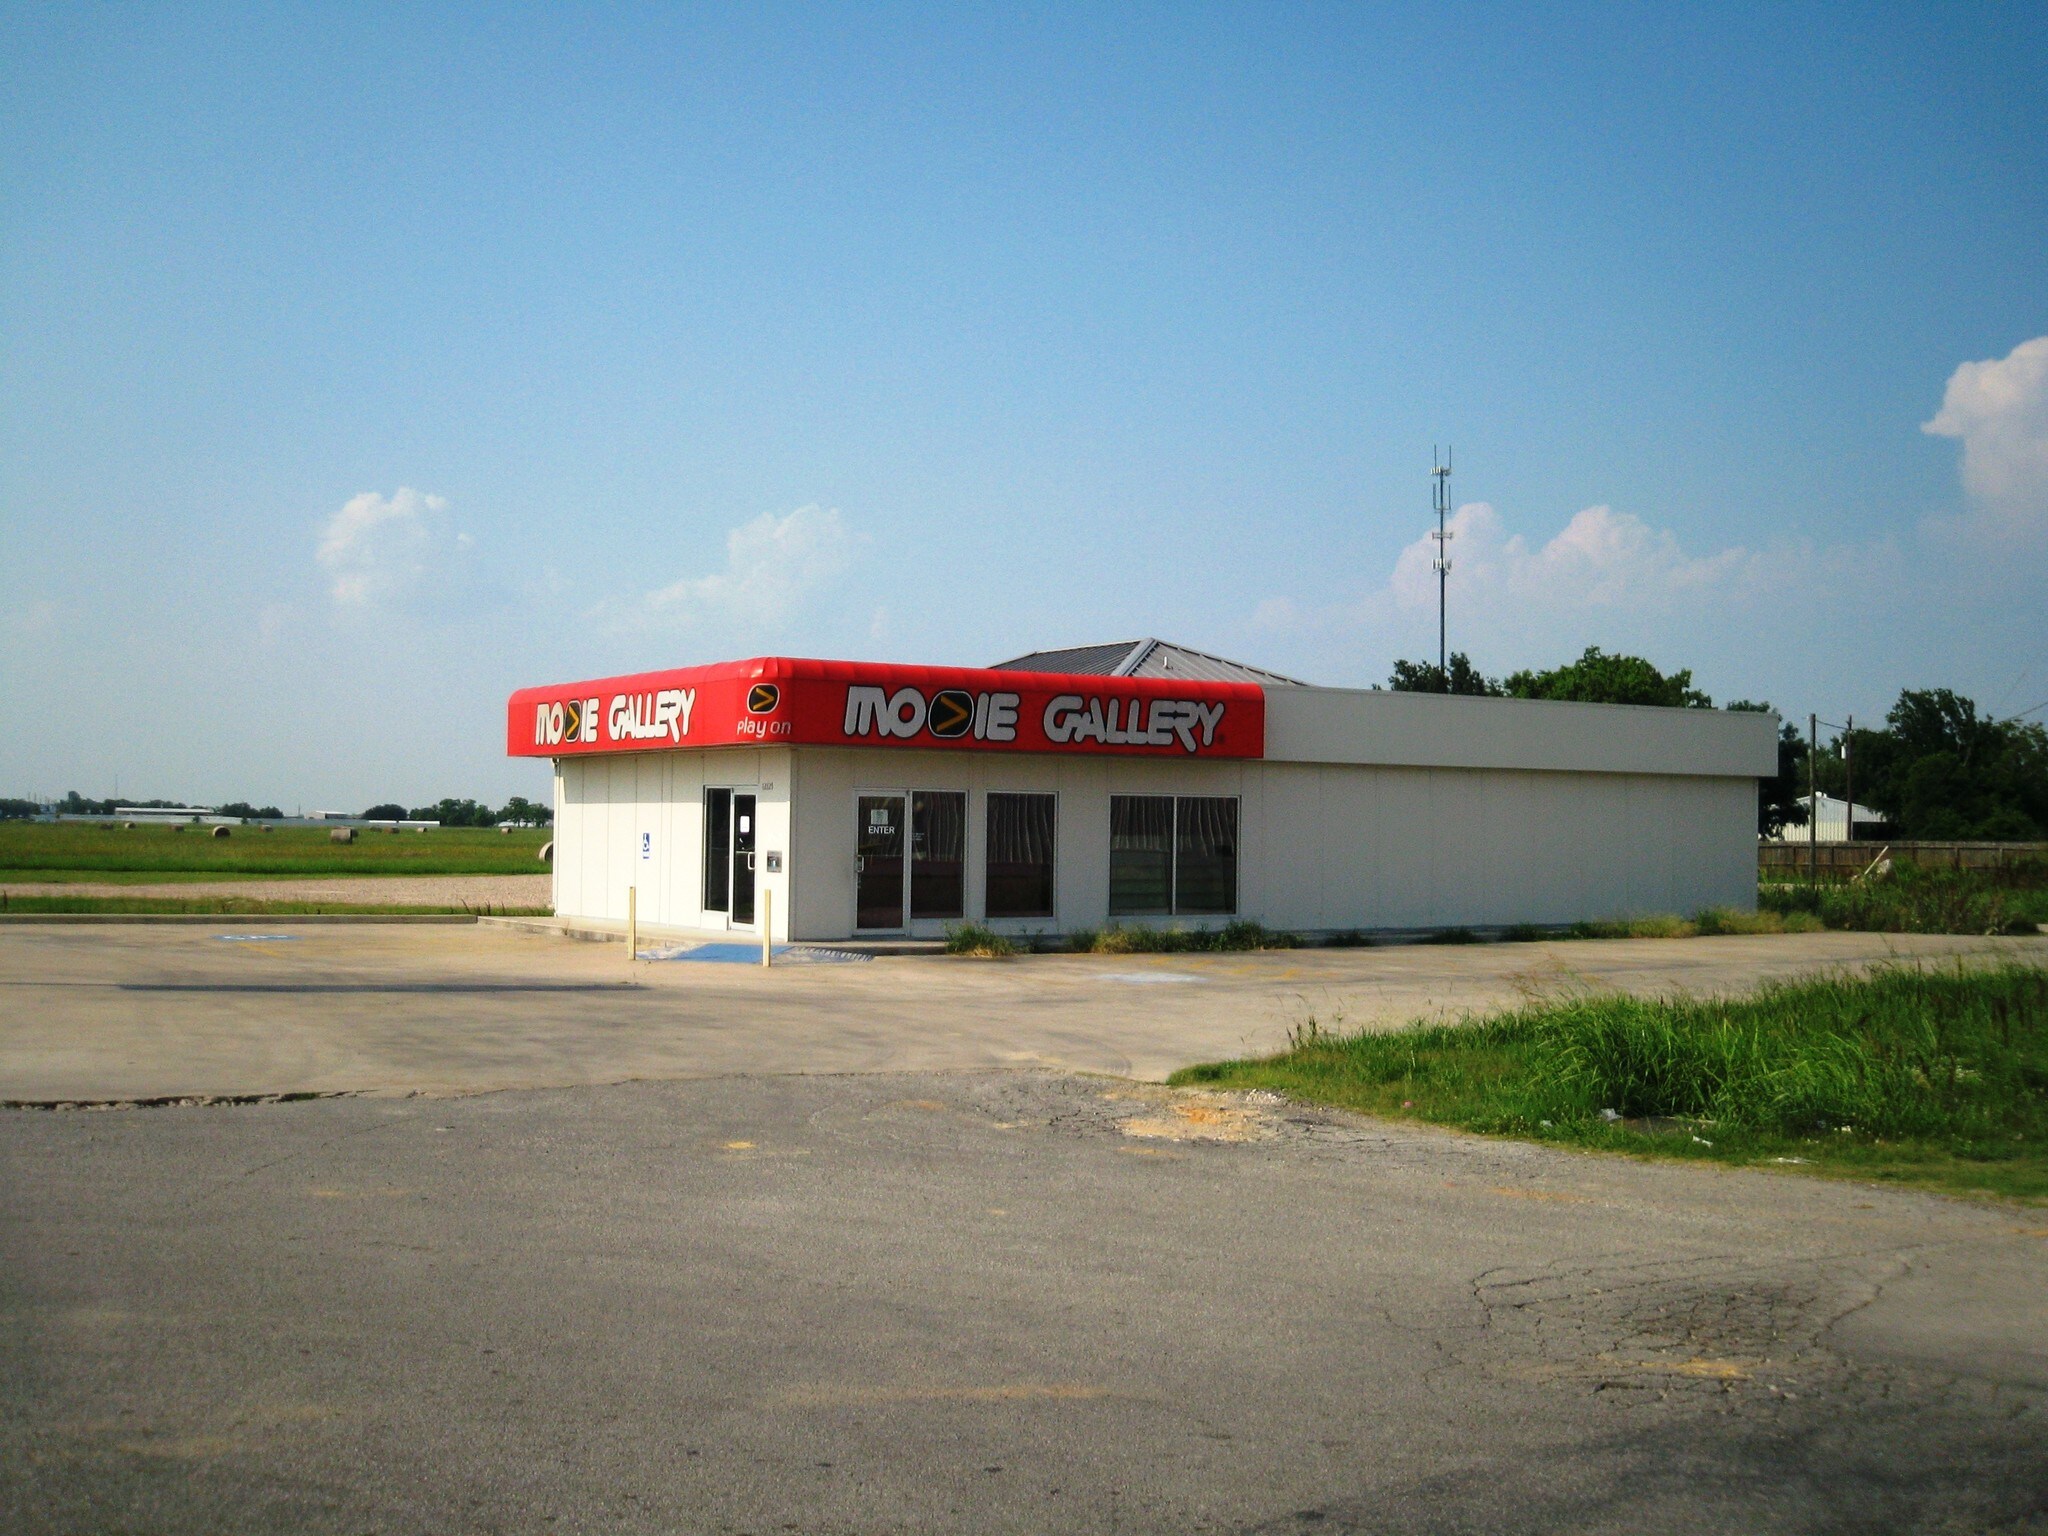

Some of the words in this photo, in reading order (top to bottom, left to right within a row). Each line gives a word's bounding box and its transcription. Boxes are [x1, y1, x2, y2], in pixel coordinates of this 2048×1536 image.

[608, 687, 697, 744] GALLERY
[736, 716, 766, 739] play
[770, 720, 792, 735] on
[1042, 694, 1226, 754] GALLERY
[868, 826, 895, 835] ENTER
